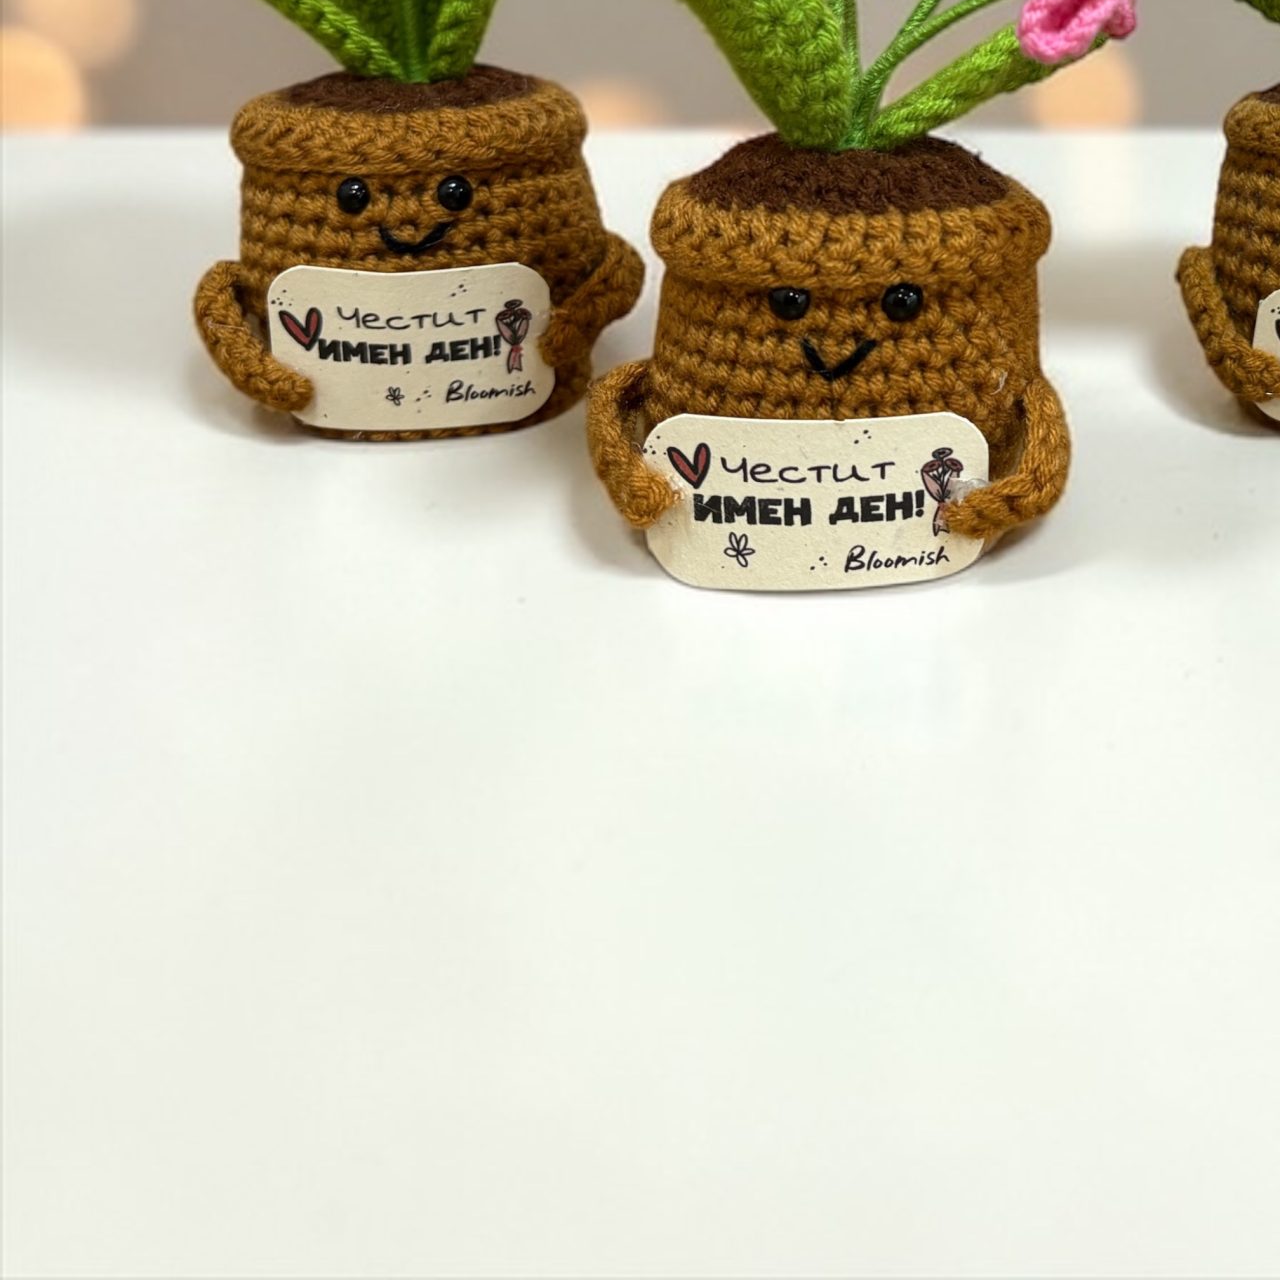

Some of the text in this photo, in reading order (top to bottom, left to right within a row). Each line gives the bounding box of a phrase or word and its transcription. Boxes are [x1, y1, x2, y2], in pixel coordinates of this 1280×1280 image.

[336, 306, 487, 330] Честит
[318, 334, 501, 365] ИМЕН ДЕН!
[445, 380, 536, 403] Bloomish
[720, 457, 895, 483] Честит
[693, 490, 925, 526] ИМЕН ДЕН!
[844, 545, 950, 572] Bloomish
